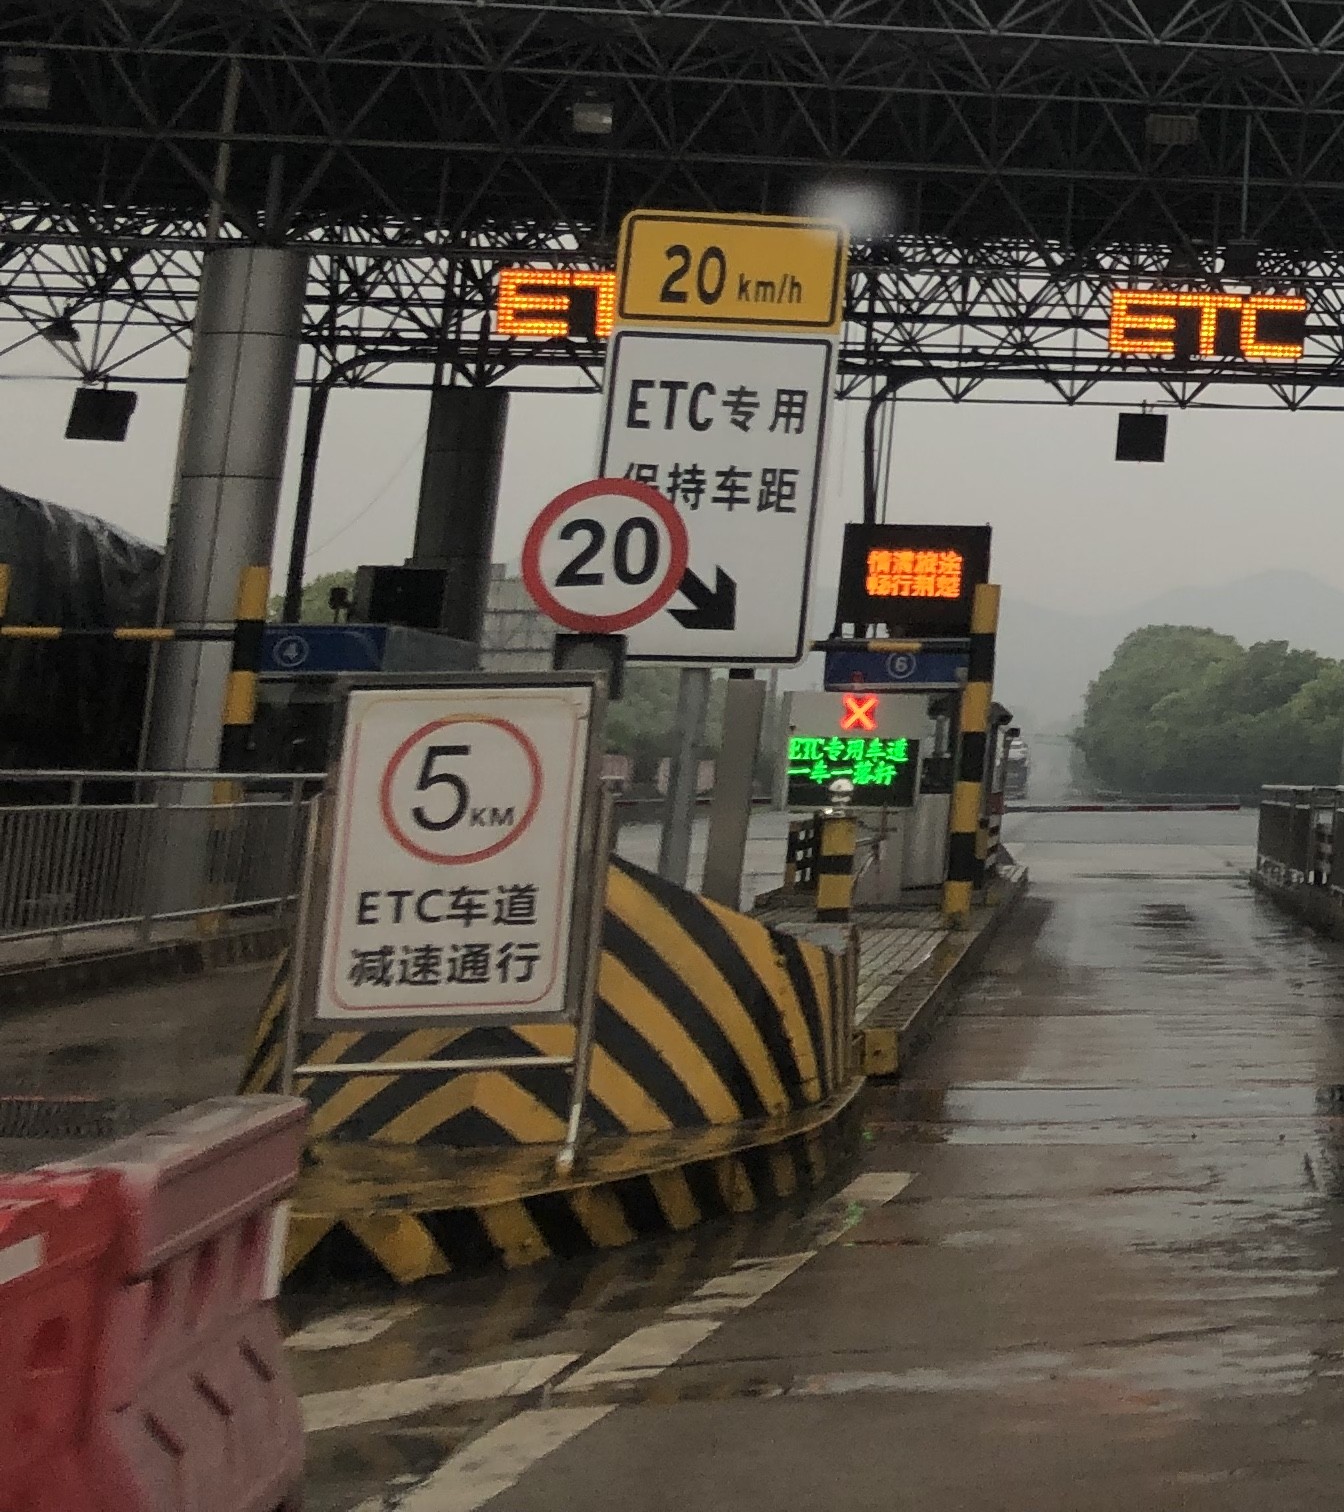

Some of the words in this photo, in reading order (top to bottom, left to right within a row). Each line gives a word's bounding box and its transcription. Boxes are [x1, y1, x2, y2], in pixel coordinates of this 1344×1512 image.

[496, 268, 617, 337] ET
[659, 244, 728, 305] 20
[737, 272, 804, 305] km/h
[1108, 289, 1307, 359] ETC
[626, 378, 810, 435] ETC专用
[555, 516, 661, 587] 20
[355, 883, 541, 928] ETC车道
[348, 941, 543, 987] 减速通行
